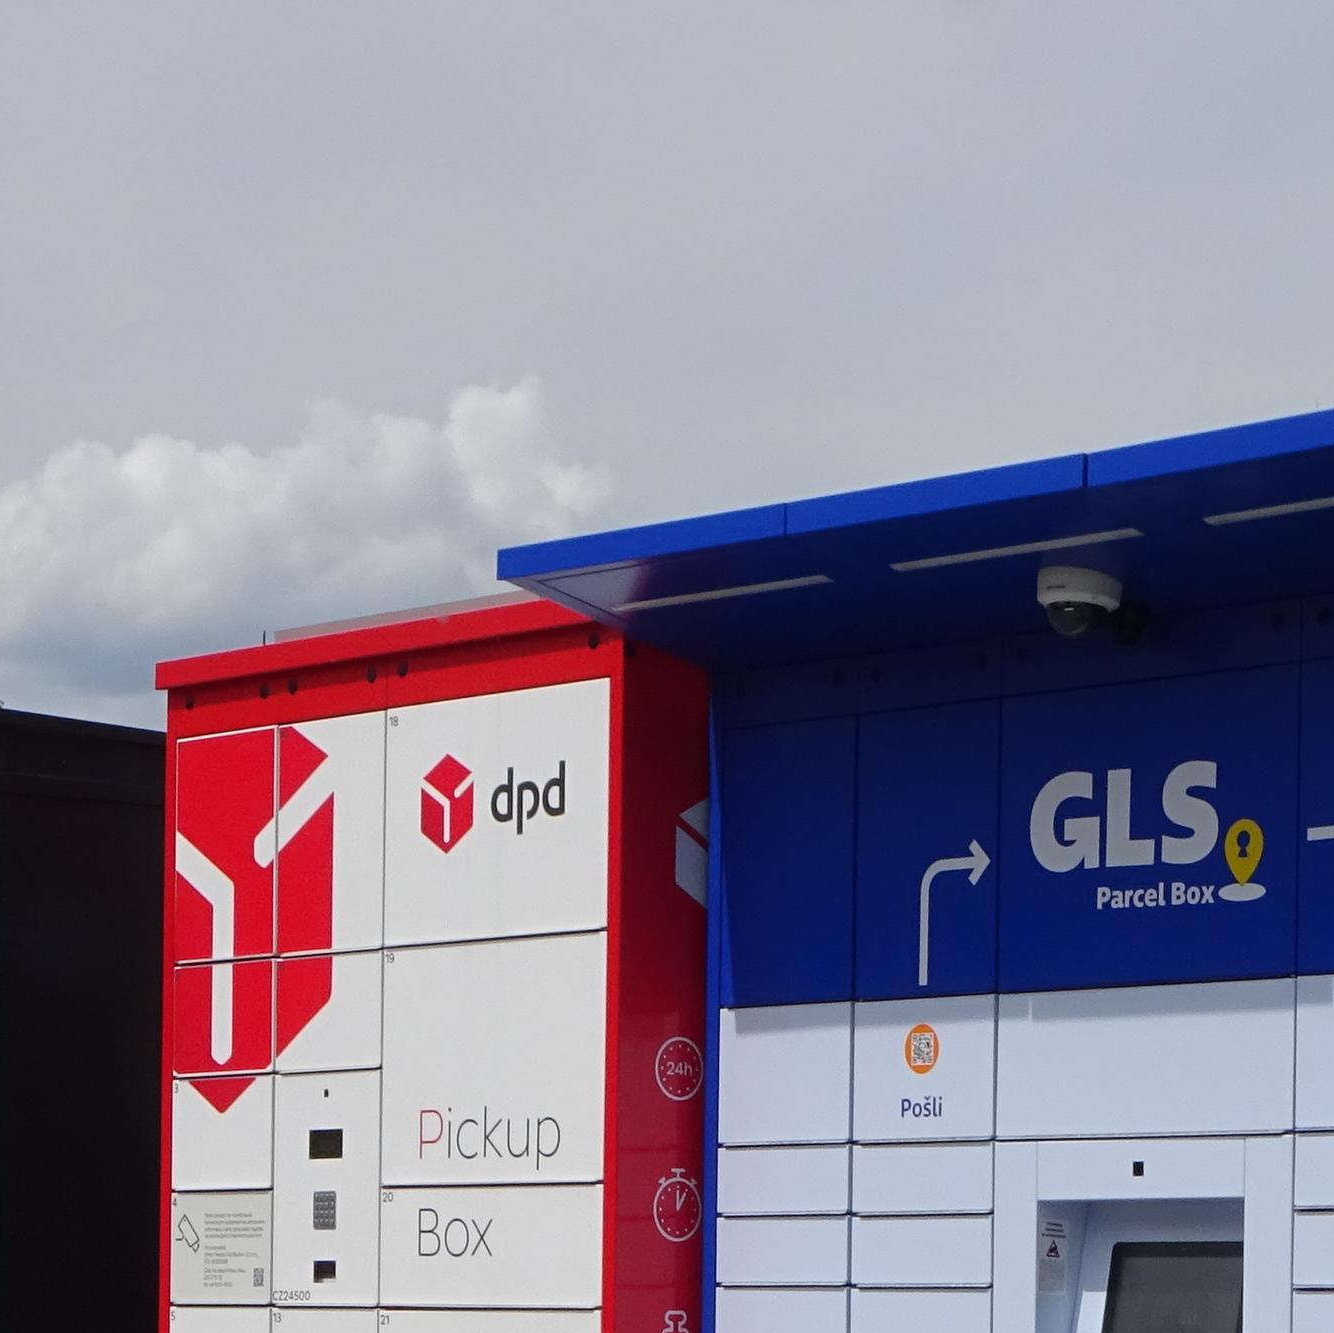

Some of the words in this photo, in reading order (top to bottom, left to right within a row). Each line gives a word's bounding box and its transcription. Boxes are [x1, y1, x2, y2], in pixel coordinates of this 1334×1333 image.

[389, 716, 399, 726] 18
[491, 760, 566, 835] dpd
[1029, 760, 1219, 874] GLS
[1096, 884, 1166, 910] Parcel
[1171, 880, 1215, 906] Box
[386, 953, 395, 963] 19
[666, 1060, 693, 1076] 24h
[901, 1095, 943, 1118] Pošli
[419, 1107, 561, 1170] Pickup
[382, 1192, 394, 1202] 20
[417, 1208, 493, 1258] Box
[272, 1290, 311, 1301] CZ24500
[273, 1313, 282, 1323] 13
[380, 1314, 390, 1325] 21
